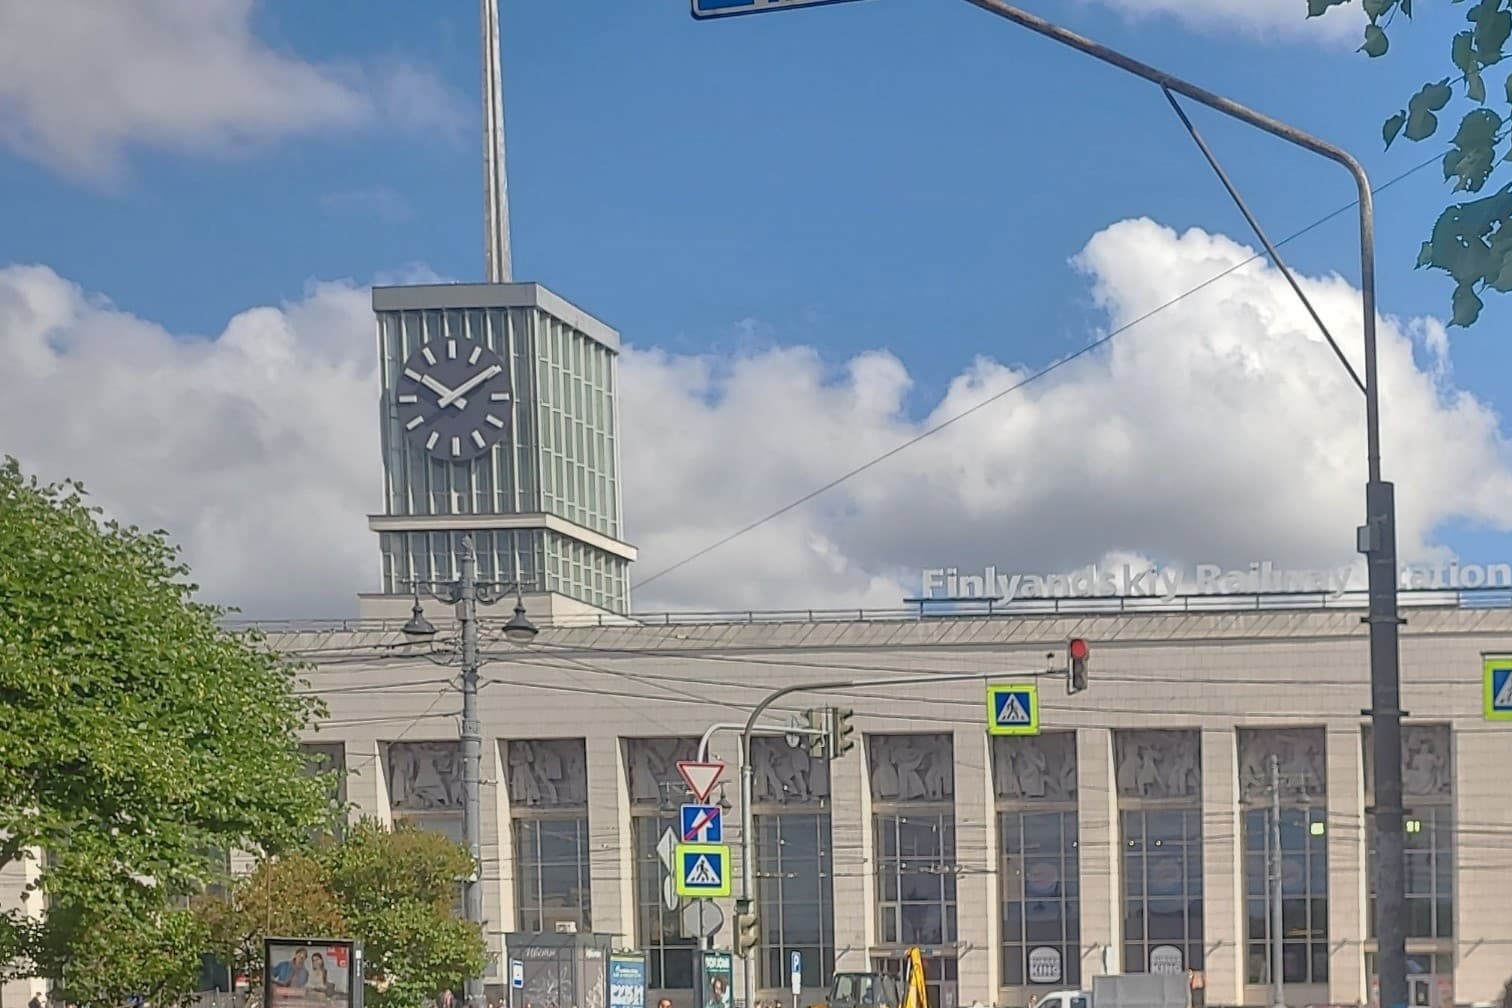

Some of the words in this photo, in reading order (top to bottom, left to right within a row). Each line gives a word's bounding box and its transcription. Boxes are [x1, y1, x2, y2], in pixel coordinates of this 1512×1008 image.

[922, 564, 1183, 606] Finlyandskiy
[1195, 560, 1352, 599] Railway
[1398, 558, 1512, 590] tation
